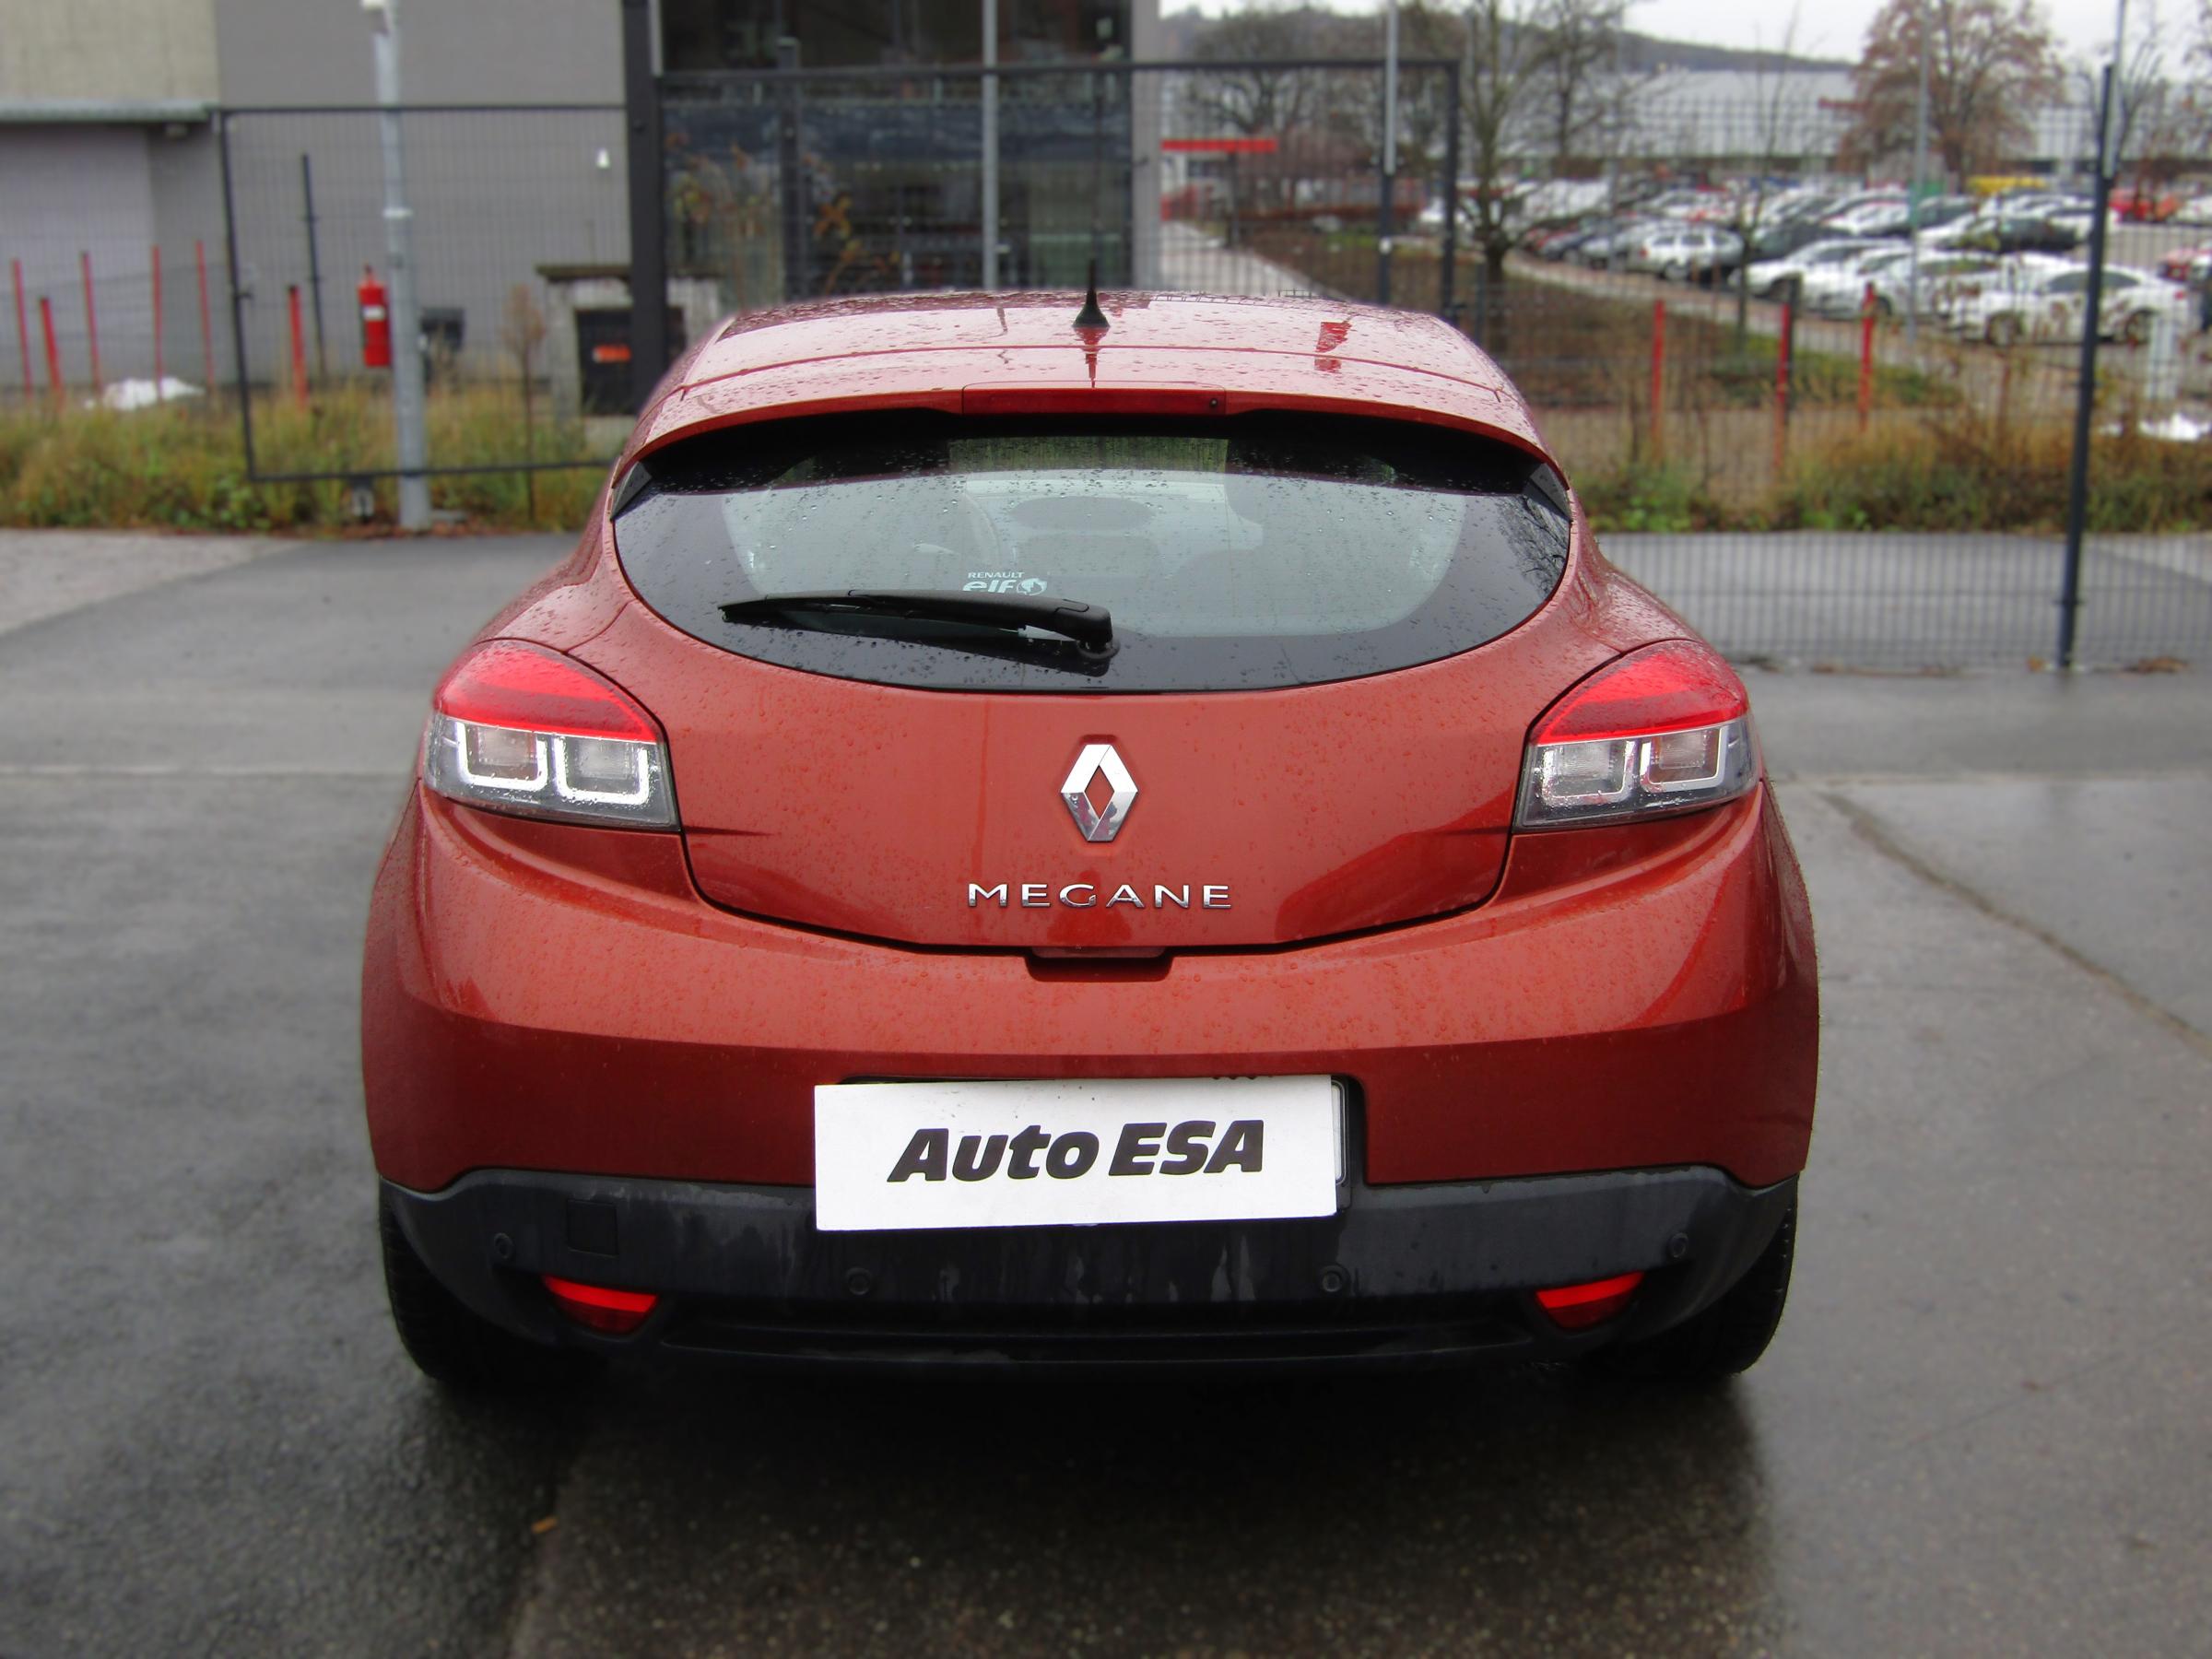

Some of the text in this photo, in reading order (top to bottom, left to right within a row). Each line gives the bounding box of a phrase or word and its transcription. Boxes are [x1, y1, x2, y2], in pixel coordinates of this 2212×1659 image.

[963, 579, 1017, 593] elf
[968, 884, 1231, 908] MEGANE
[887, 1119, 1264, 1182] Auto ESA
